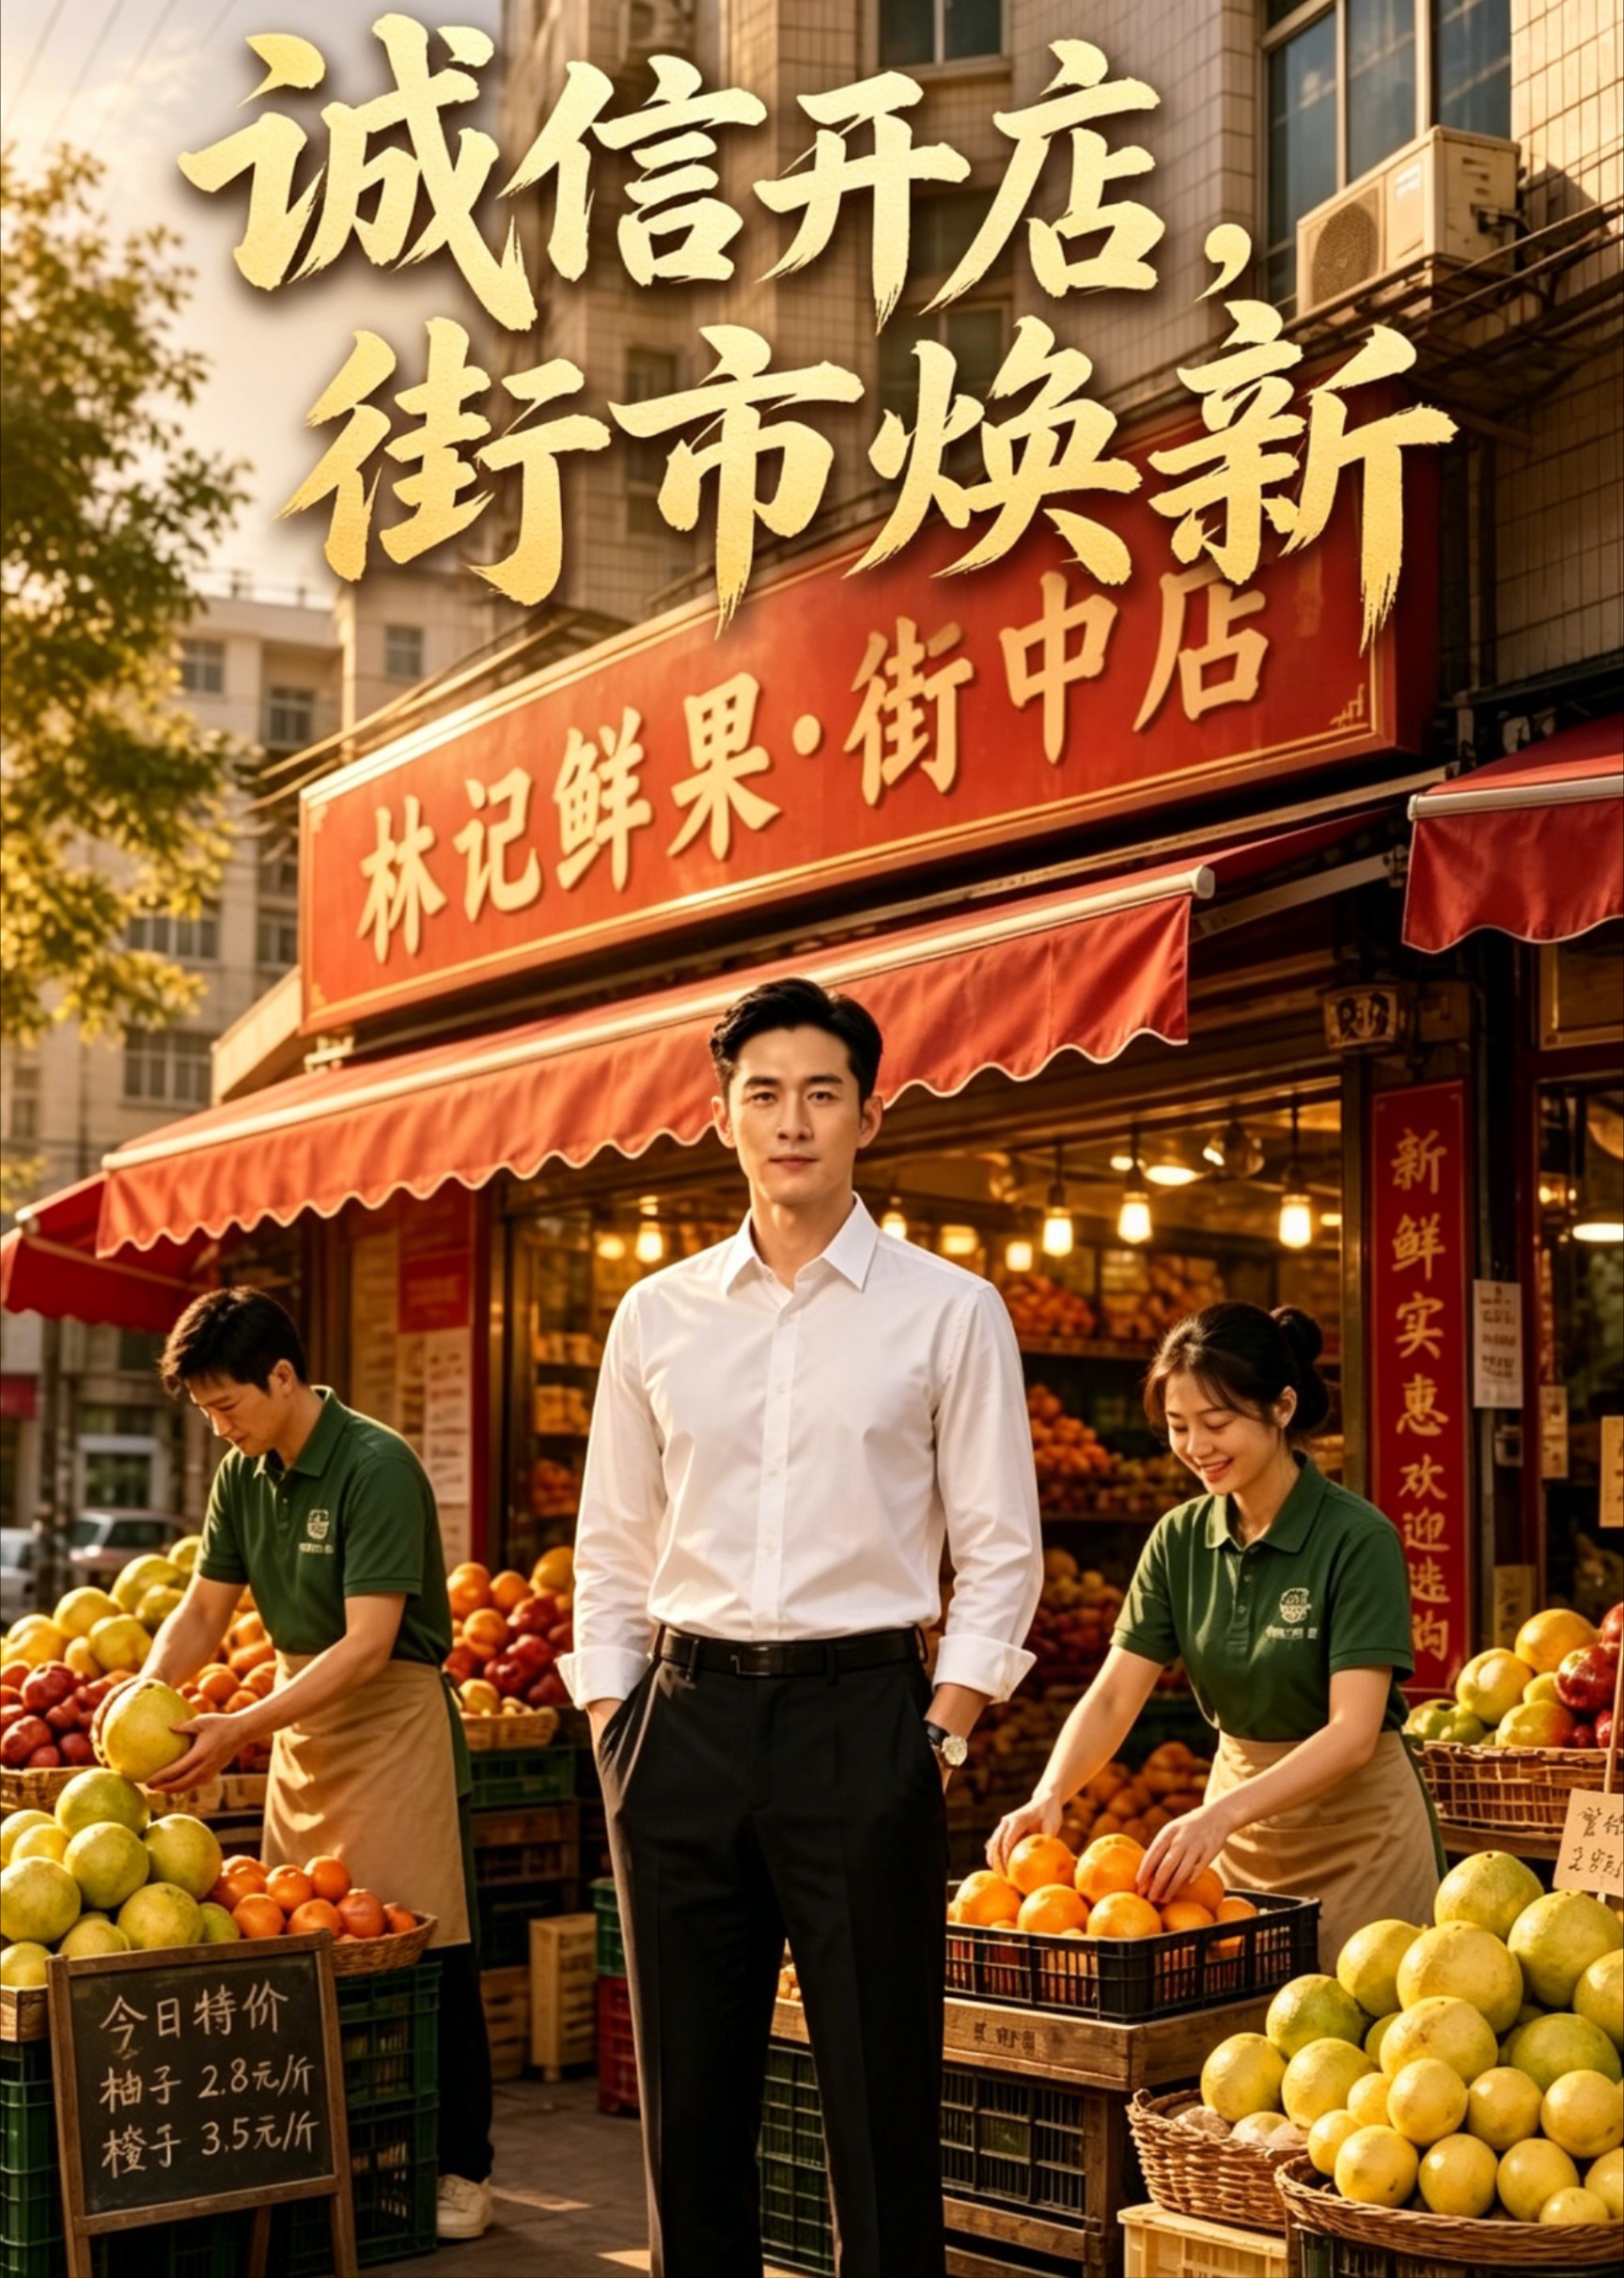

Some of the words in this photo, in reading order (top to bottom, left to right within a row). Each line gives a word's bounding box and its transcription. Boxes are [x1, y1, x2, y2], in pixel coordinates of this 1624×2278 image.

[356, 570, 1270, 965] 林记鲜果·街中店
[99, 1979, 289, 2060] 今日特价
[99, 2066, 182, 2114] 柚子
[101, 2122, 182, 2178] 橙子
